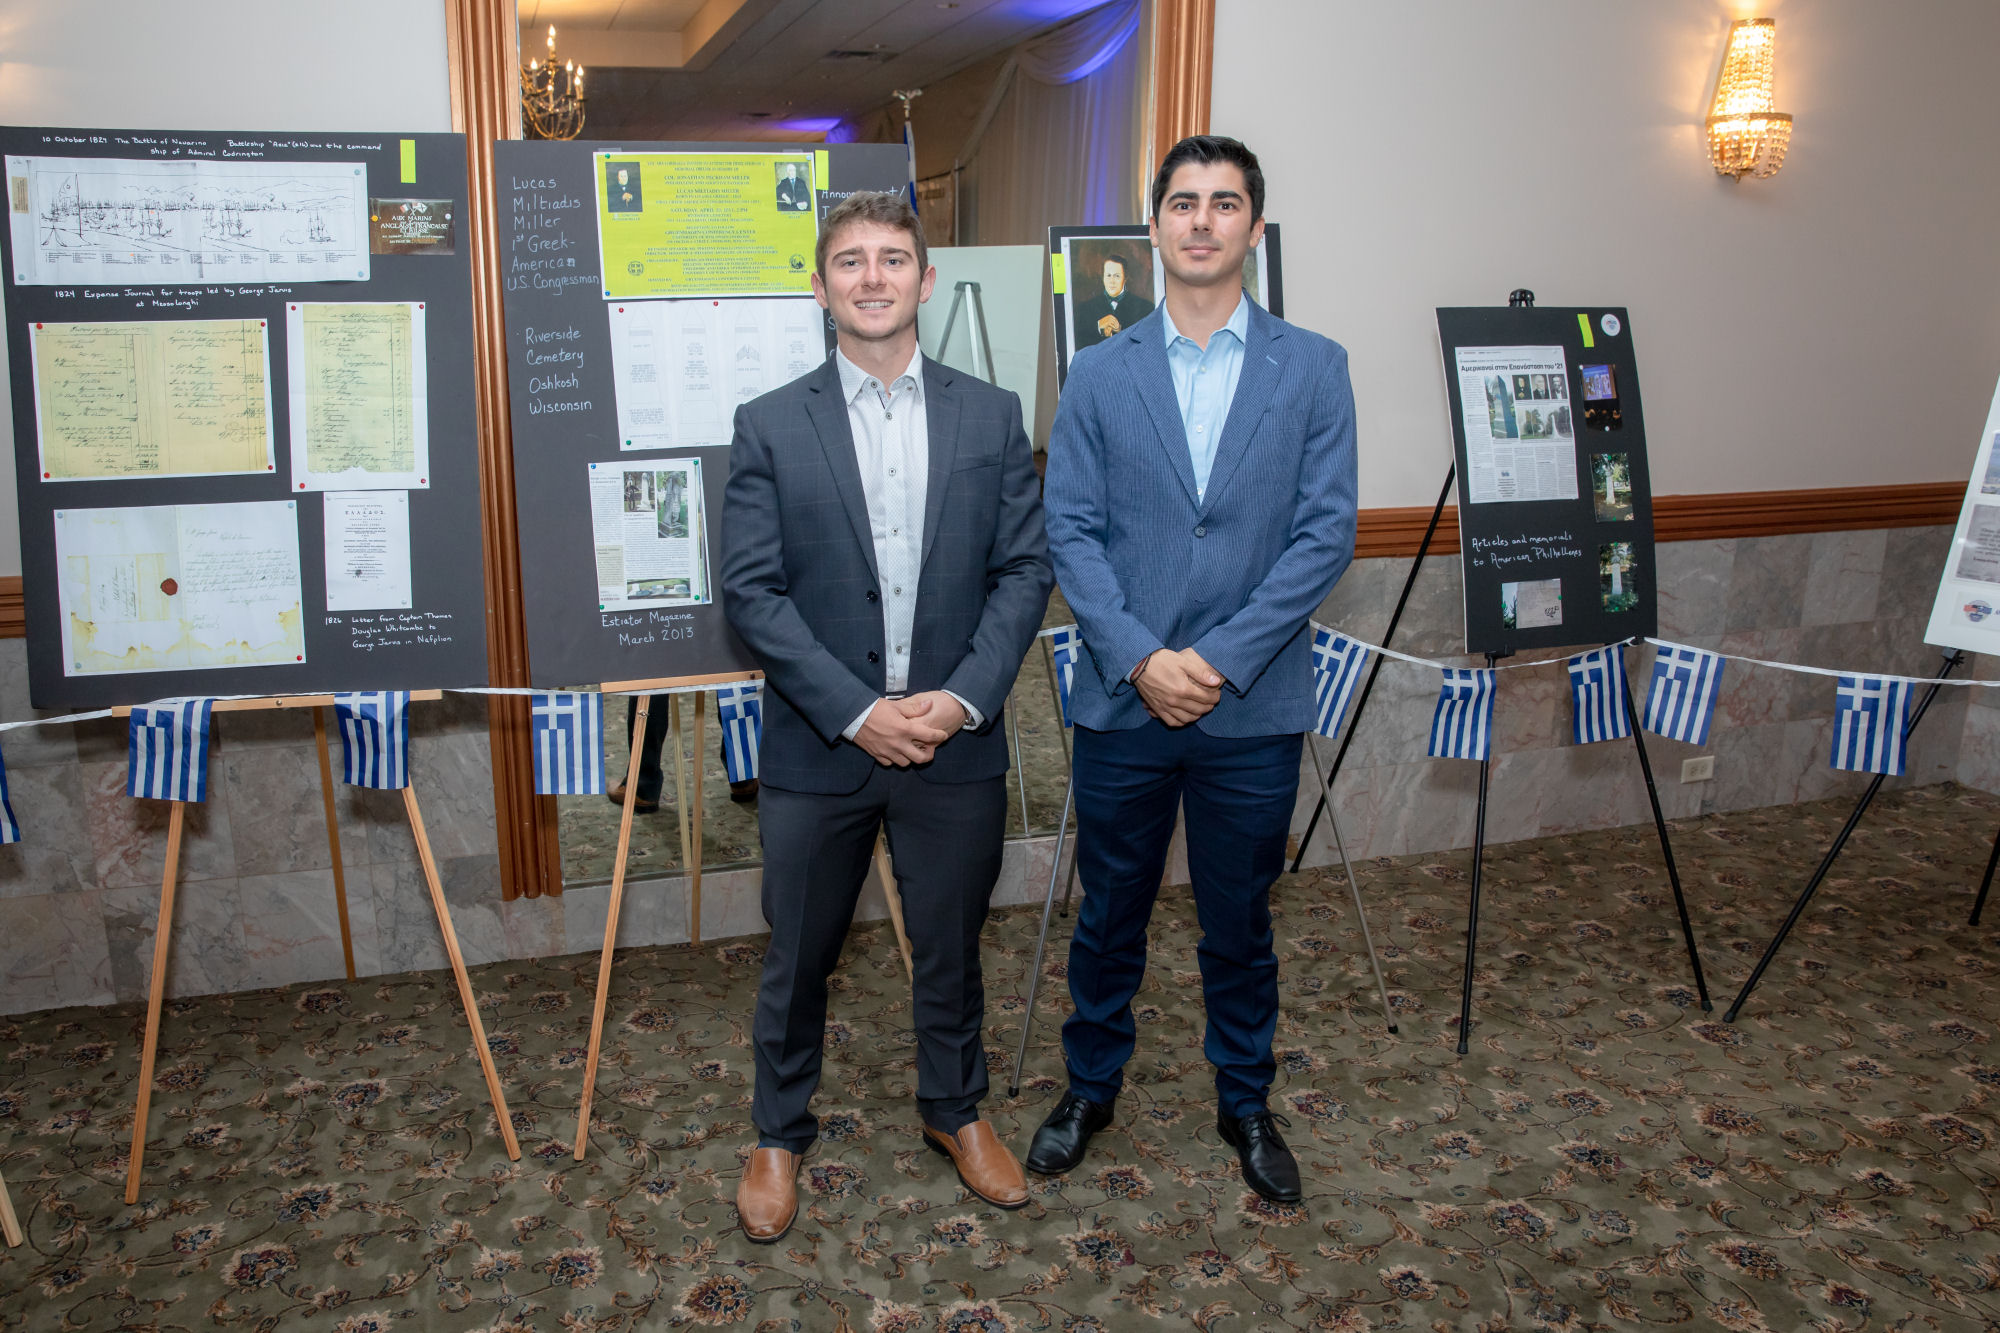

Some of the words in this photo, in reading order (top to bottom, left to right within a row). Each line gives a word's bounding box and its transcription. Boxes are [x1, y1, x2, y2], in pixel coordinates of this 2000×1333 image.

[226, 139, 264, 148] Battleship
[150, 148, 167, 156] ship
[222, 150, 264, 158] Codrington
[513, 176, 557, 190] Lucas
[513, 193, 581, 212] Miltiadis
[514, 213, 561, 230] Miller
[528, 232, 576, 253] Greek-
[512, 256, 576, 273] American
[55, 290, 75, 298] 1824
[84, 290, 119, 299] Expense
[124, 289, 154, 297] Journal
[179, 288, 203, 297] troops
[224, 287, 235, 296] by
[239, 287, 264, 296] George
[268, 285, 292, 294] Jarvis
[507, 275, 530, 291] U.S.
[533, 273, 600, 296] Congressman
[526, 325, 582, 345] Riverside
[527, 347, 584, 368] Cemetery
[529, 372, 578, 394] Oshkosh
[529, 398, 592, 415] Wisconsin
[1472, 534, 1509, 552] Articles
[1512, 534, 1528, 544] and
[1529, 530, 1572, 543] memorials
[1473, 558, 1484, 566] to
[1490, 552, 1533, 569] American
[1530, 546, 1582, 560] Philhellenes
[325, 617, 342, 625] 1826
[399, 614, 423, 622] Captain
[601, 614, 643, 627] Estiator
[649, 610, 695, 628] Magazine
[352, 626, 381, 638] Douglas
[385, 624, 423, 632] Whitcombe
[619, 632, 655, 646] March
[661, 626, 694, 641] 2013
[352, 640, 374, 651] George
[378, 638, 401, 646] Jarvis
[417, 634, 452, 645] Nafplion
